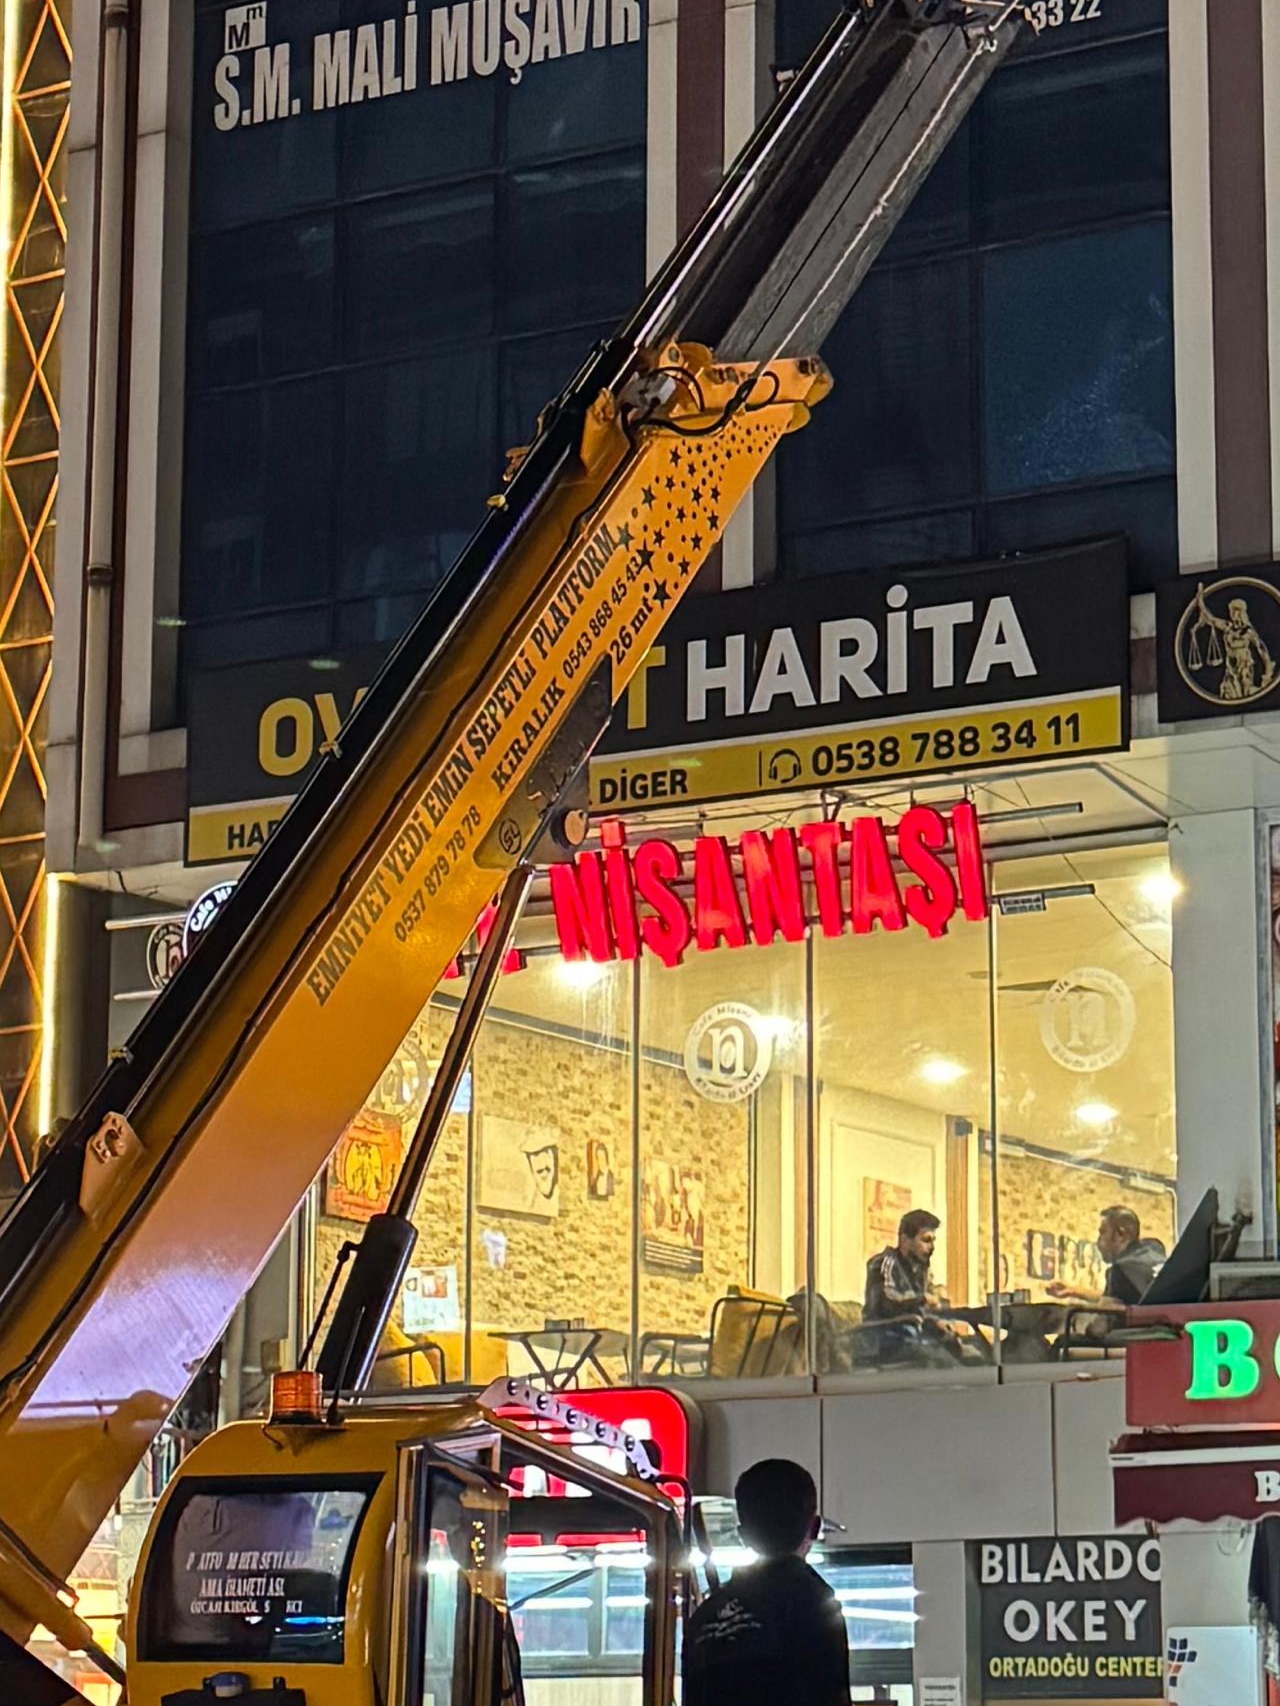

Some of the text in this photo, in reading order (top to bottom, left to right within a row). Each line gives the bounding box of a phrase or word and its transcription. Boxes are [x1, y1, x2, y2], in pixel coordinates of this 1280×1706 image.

[213, 35, 301, 131] S.M.
[313, 11, 419, 112] MALİ
[530, 522, 619, 661] PLATFORM
[562, 631, 593, 679] 0543
[588, 602, 614, 639] 868
[610, 577, 628, 606] 45
[609, 596, 655, 666] 26 mt
[685, 582, 1038, 723] HARİTA
[812, 735, 900, 777] 0538
[911, 724, 981, 764] 788
[990, 718, 1037, 754] 34
[1046, 712, 1081, 747] 11
[394, 804, 483, 943] 0537 879 78 78
[549, 798, 992, 970] NİŞANTAŞI
[989, 1652, 1089, 1679] ORTADOĞU
[1003, 1598, 1147, 1643] OKEY
